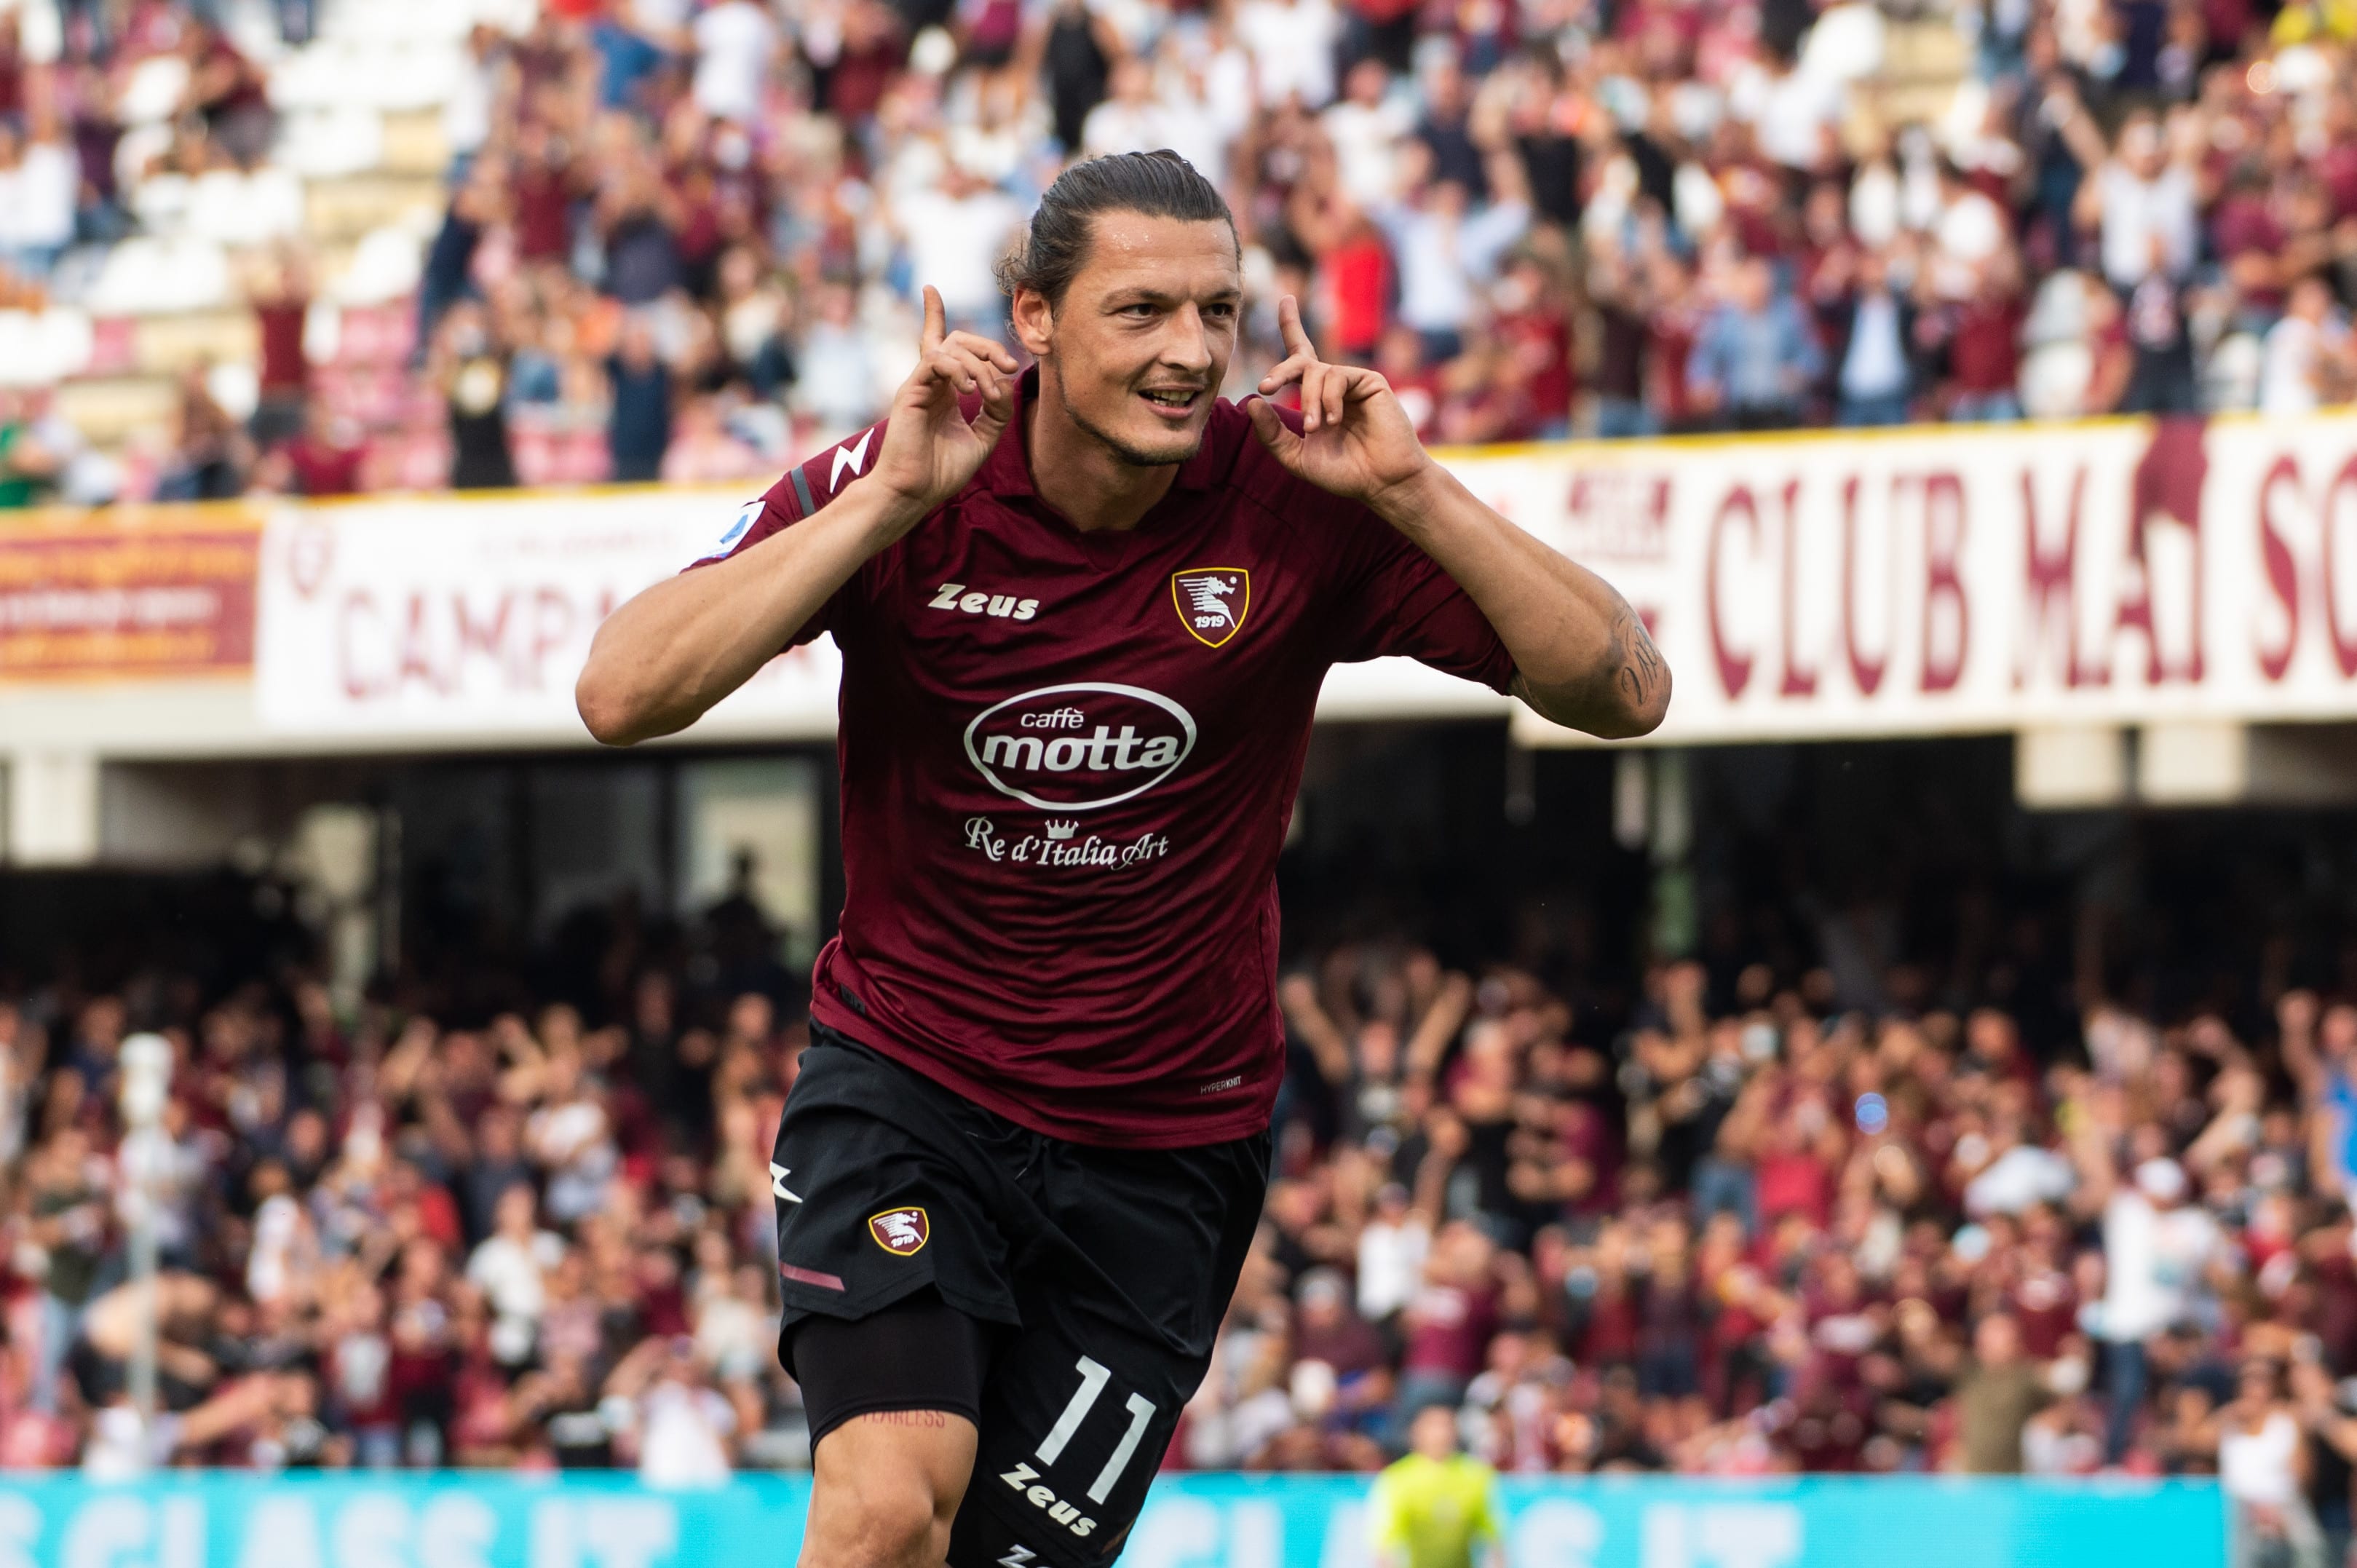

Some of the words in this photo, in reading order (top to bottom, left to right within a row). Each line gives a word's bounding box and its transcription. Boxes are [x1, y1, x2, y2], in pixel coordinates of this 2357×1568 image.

[927, 583, 1039, 620] Zeus
[1703, 470, 1971, 702] CLUB
[336, 579, 627, 703] CAMP
[1195, 614, 1226, 628] 1919
[1020, 707, 1085, 729] caffè
[982, 725, 1179, 772] motta
[964, 816, 1006, 862] Re
[1011, 835, 1117, 866] d'Italia
[1111, 833, 1169, 871] Art
[1200, 1075, 1241, 1094] HYPERKNIT
[890, 1234, 915, 1248] 1919
[1034, 1354, 1157, 1505] 11
[999, 1462, 1098, 1537] Zeus
